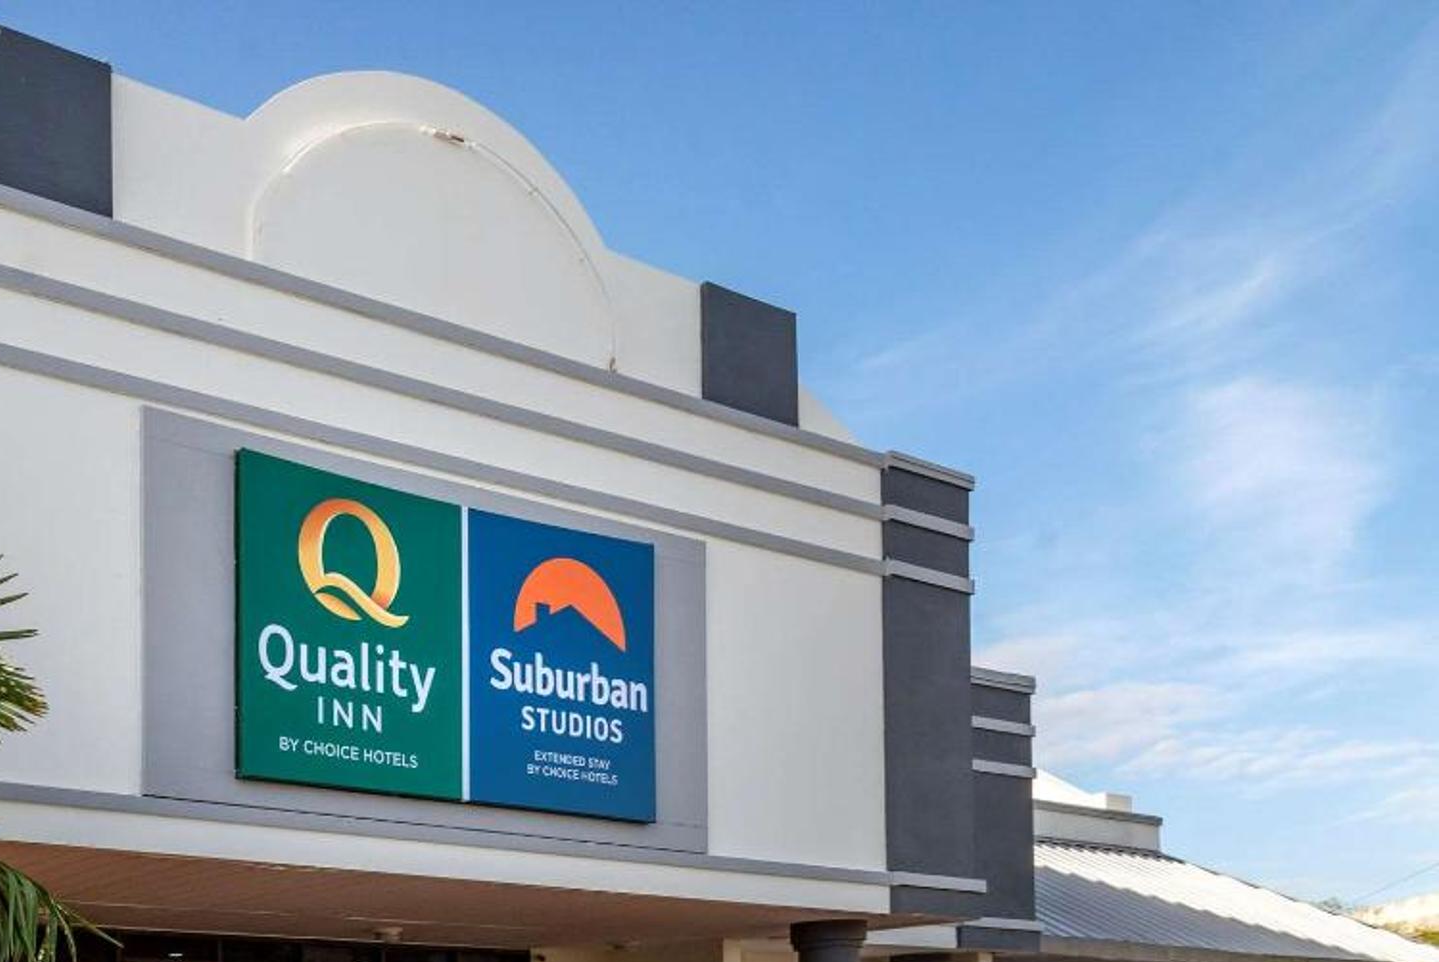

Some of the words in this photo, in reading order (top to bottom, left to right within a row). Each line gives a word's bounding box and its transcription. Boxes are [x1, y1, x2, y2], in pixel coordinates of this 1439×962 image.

[259, 624, 436, 713] Quality
[490, 647, 648, 712] Suburban
[317, 696, 382, 733] INN
[521, 705, 623, 743] STUDIOS
[279, 736, 299, 752] BY
[303, 740, 360, 761] CHOICE
[363, 748, 419, 769] HOTELS
[534, 750, 586, 767] EXTENDED
[588, 757, 611, 770] STAY
[526, 763, 541, 775] BY
[542, 765, 580, 780] CHOICE
[581, 771, 619, 785] HOTELS
